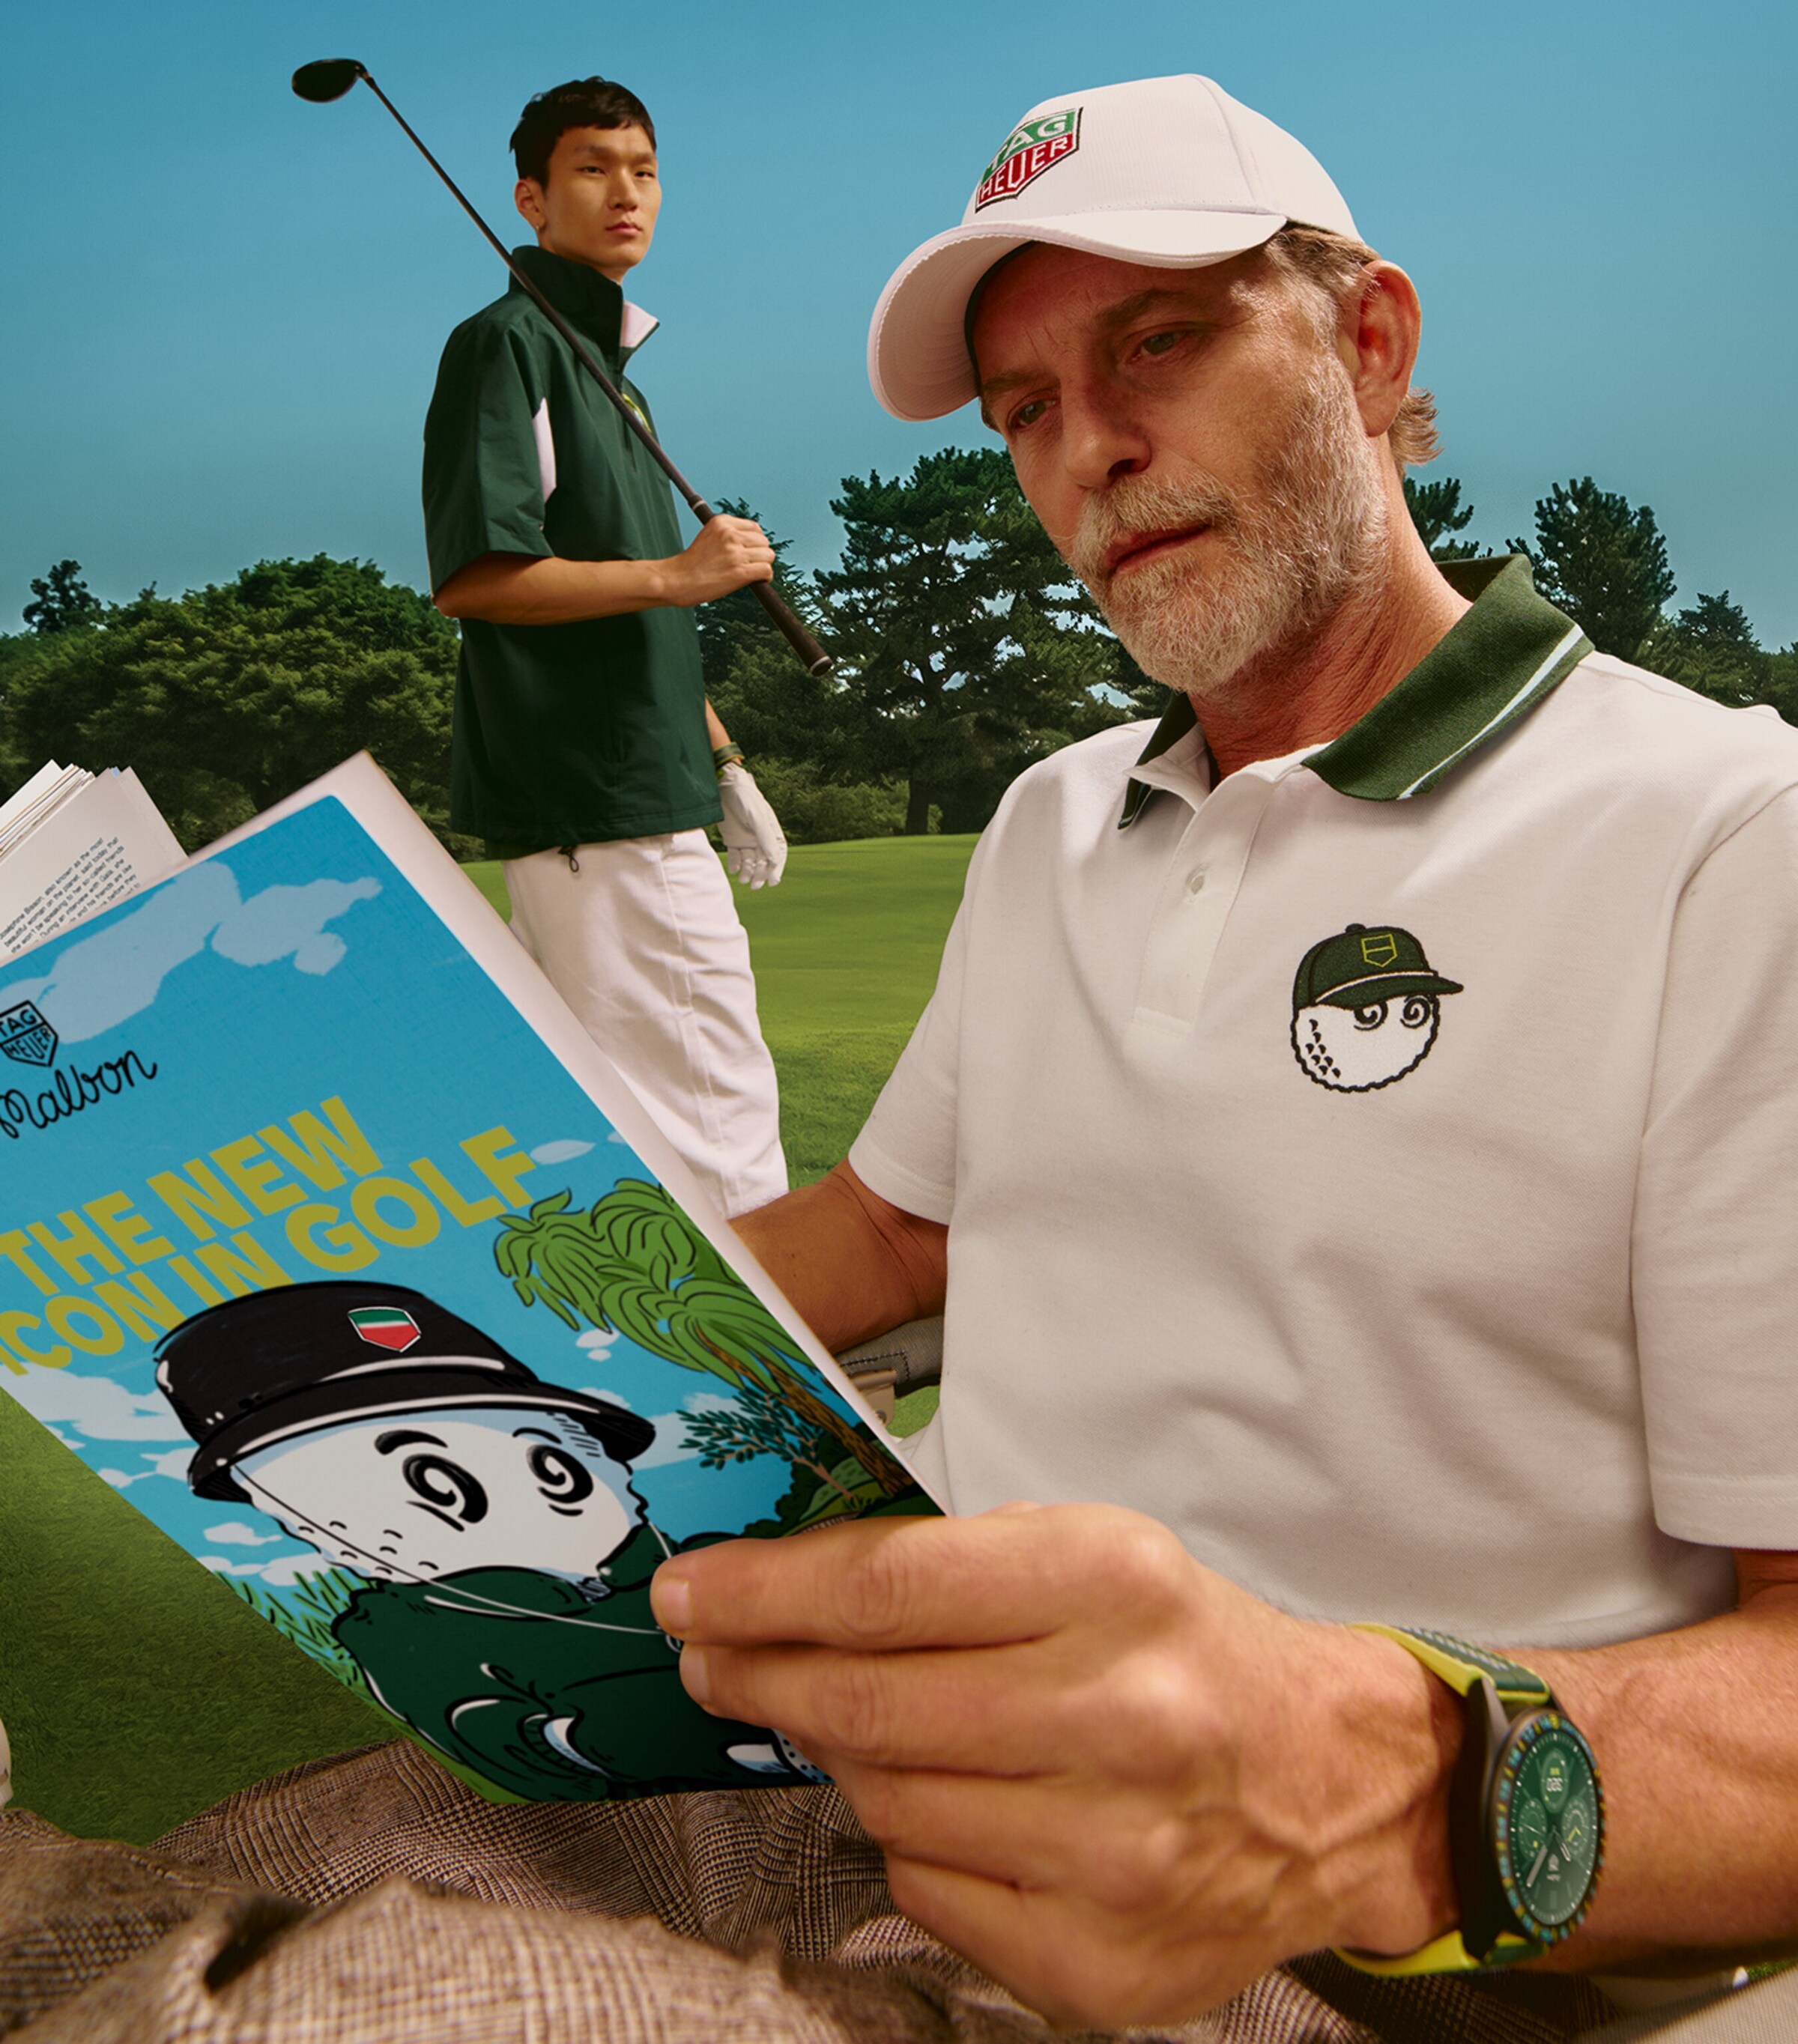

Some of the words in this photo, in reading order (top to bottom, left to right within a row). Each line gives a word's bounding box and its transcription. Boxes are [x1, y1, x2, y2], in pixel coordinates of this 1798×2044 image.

[980, 136, 1068, 201] HEUER
[987, 115, 1068, 172] TAG
[55, 867, 73, 885] known
[89, 837, 104, 852] most
[4, 924, 28, 947] beautiful
[27, 906, 46, 926] woman
[91, 848, 109, 864] today
[106, 836, 119, 849] that
[43, 900, 69, 924] speaking
[65, 893, 89, 915] interview
[88, 881, 100, 894] with
[106, 884, 125, 903] before
[6, 1027, 51, 1060] HEUER
[0, 1050, 157, 1139] Malbon
[0, 1190, 177, 1297] THE
[146, 1095, 384, 1242] NEW
[166, 1231, 295, 1308] IN
[285, 1125, 536, 1272] GOLF
